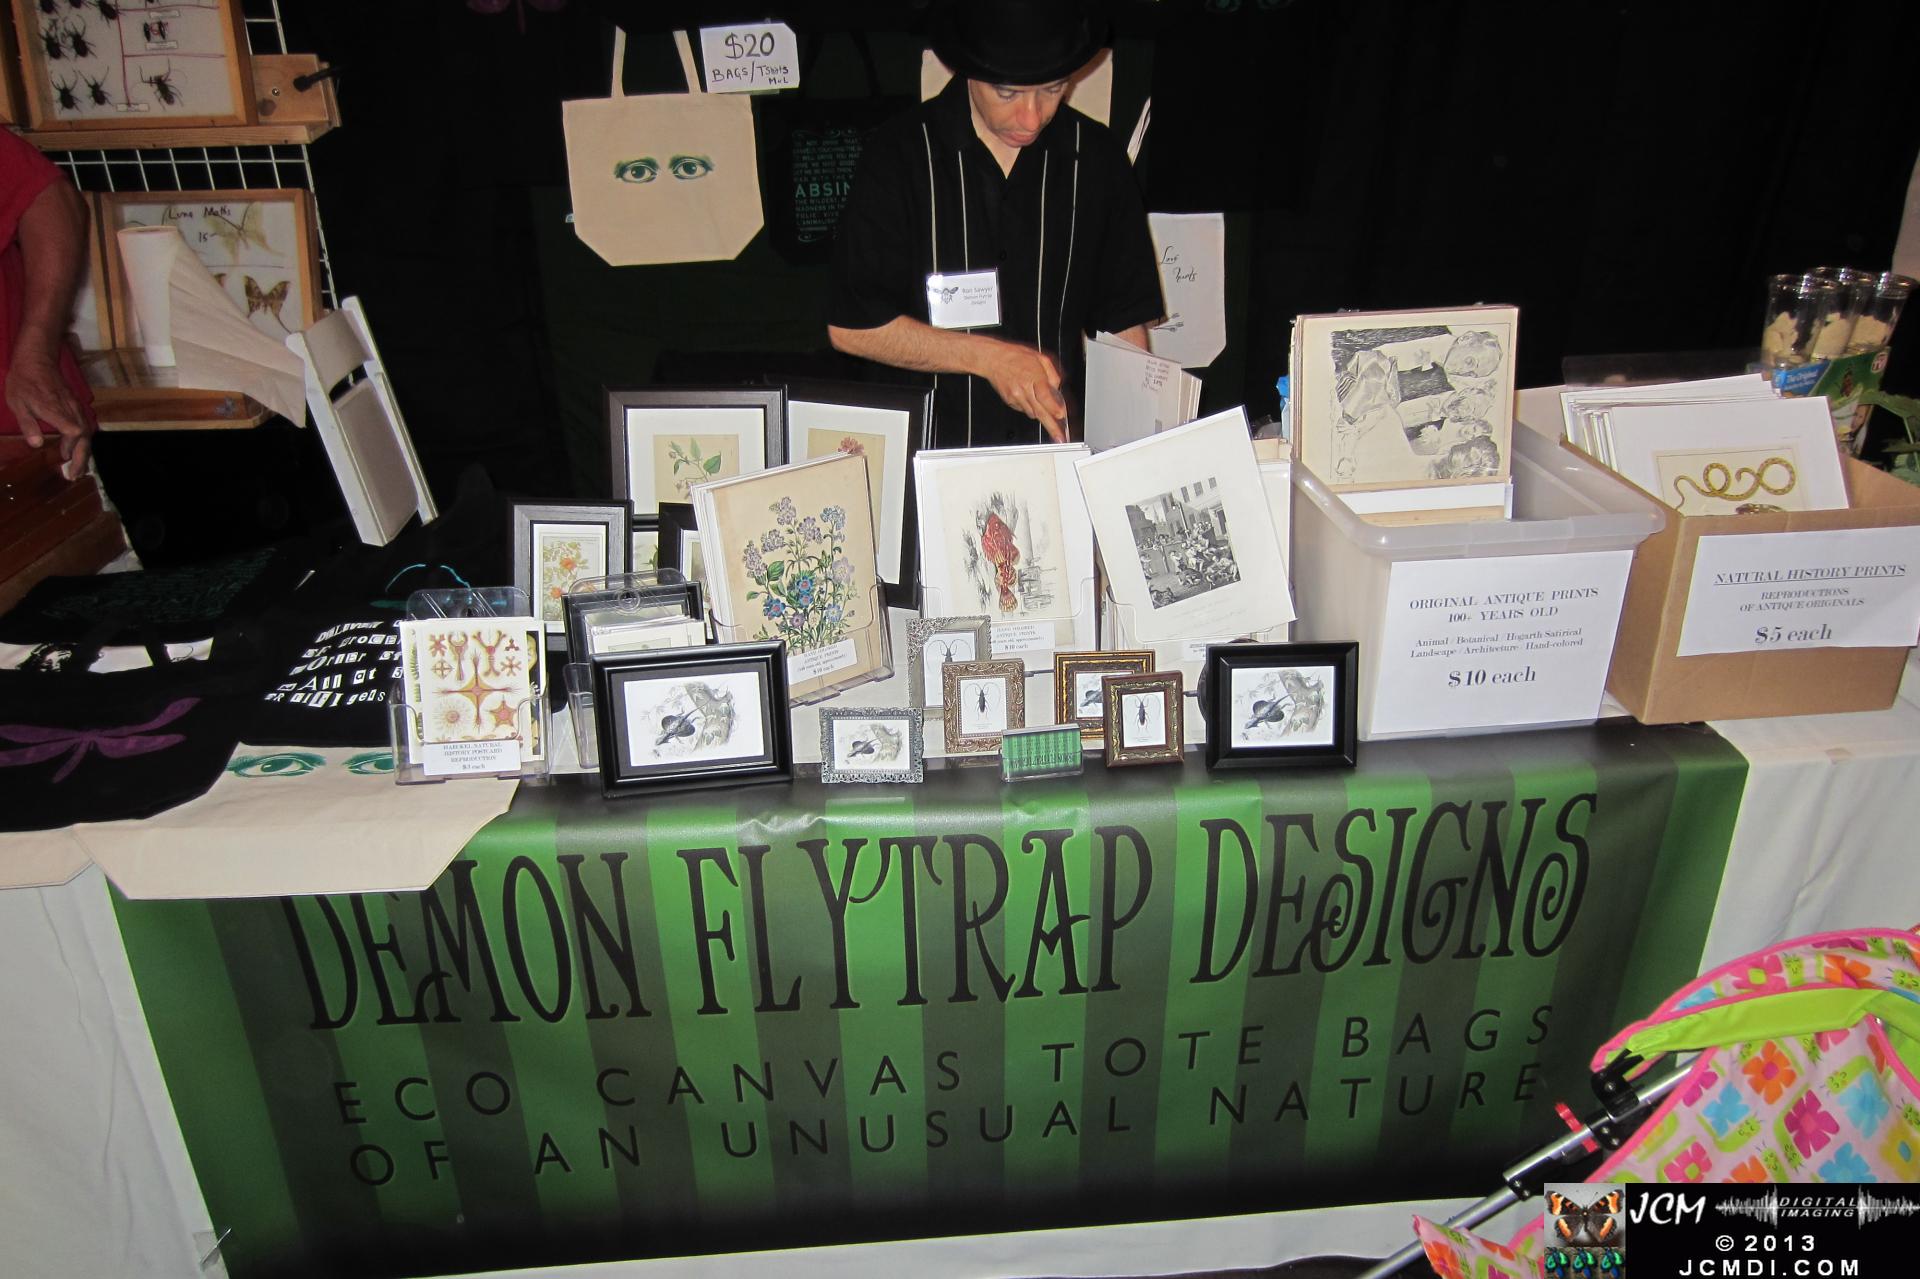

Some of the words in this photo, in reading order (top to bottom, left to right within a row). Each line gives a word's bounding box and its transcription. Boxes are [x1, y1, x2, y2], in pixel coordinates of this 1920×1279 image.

[724, 32, 775, 60] $20
[1714, 569, 1784, 584] NATURAL
[1787, 566, 1851, 580] HISTORY
[1854, 563, 1906, 577] PRINTS
[1409, 595, 1478, 610] ORIGINAL
[1484, 591, 1545, 606] ANTIQUE
[1551, 587, 1600, 600] PRINTS
[1761, 587, 1849, 601] REPRODUCTIONS
[1480, 610, 1524, 621] YEARS
[1530, 607, 1558, 618] OLD
[1740, 603, 1756, 613] OF
[1757, 600, 1805, 612] ANTIQUE
[1806, 597, 1865, 609] ORIGINALS
[1415, 637, 1449, 648] Animal
[1456, 633, 1499, 645] Botanical
[1506, 631, 1542, 643] Hogarth
[1544, 627, 1582, 637] Satirical
[1754, 625, 1781, 645] $5
[1787, 623, 1834, 642] each
[1410, 647, 1457, 659] Landscape
[1464, 644, 1519, 655] Architecture
[1525, 638, 1584, 651] Hand-colored
[1448, 668, 1487, 688] $10
[1491, 666, 1537, 684] each
[346, 688, 387, 706] gets
[280, 851, 652, 1030] DEMON
[676, 823, 1152, 1016] FLYTRAP
[1188, 792, 1598, 985] DESIGNS
[334, 1070, 511, 1122] ECO
[596, 1050, 960, 1107] CANVAS
[1041, 1025, 1264, 1083] TOTE
[1341, 1005, 1553, 1059] BAGS
[350, 1140, 450, 1187] OF
[534, 1125, 641, 1175] AN
[721, 1096, 1131, 1159] UNUSUAL
[1209, 1063, 1541, 1126] NATURE
